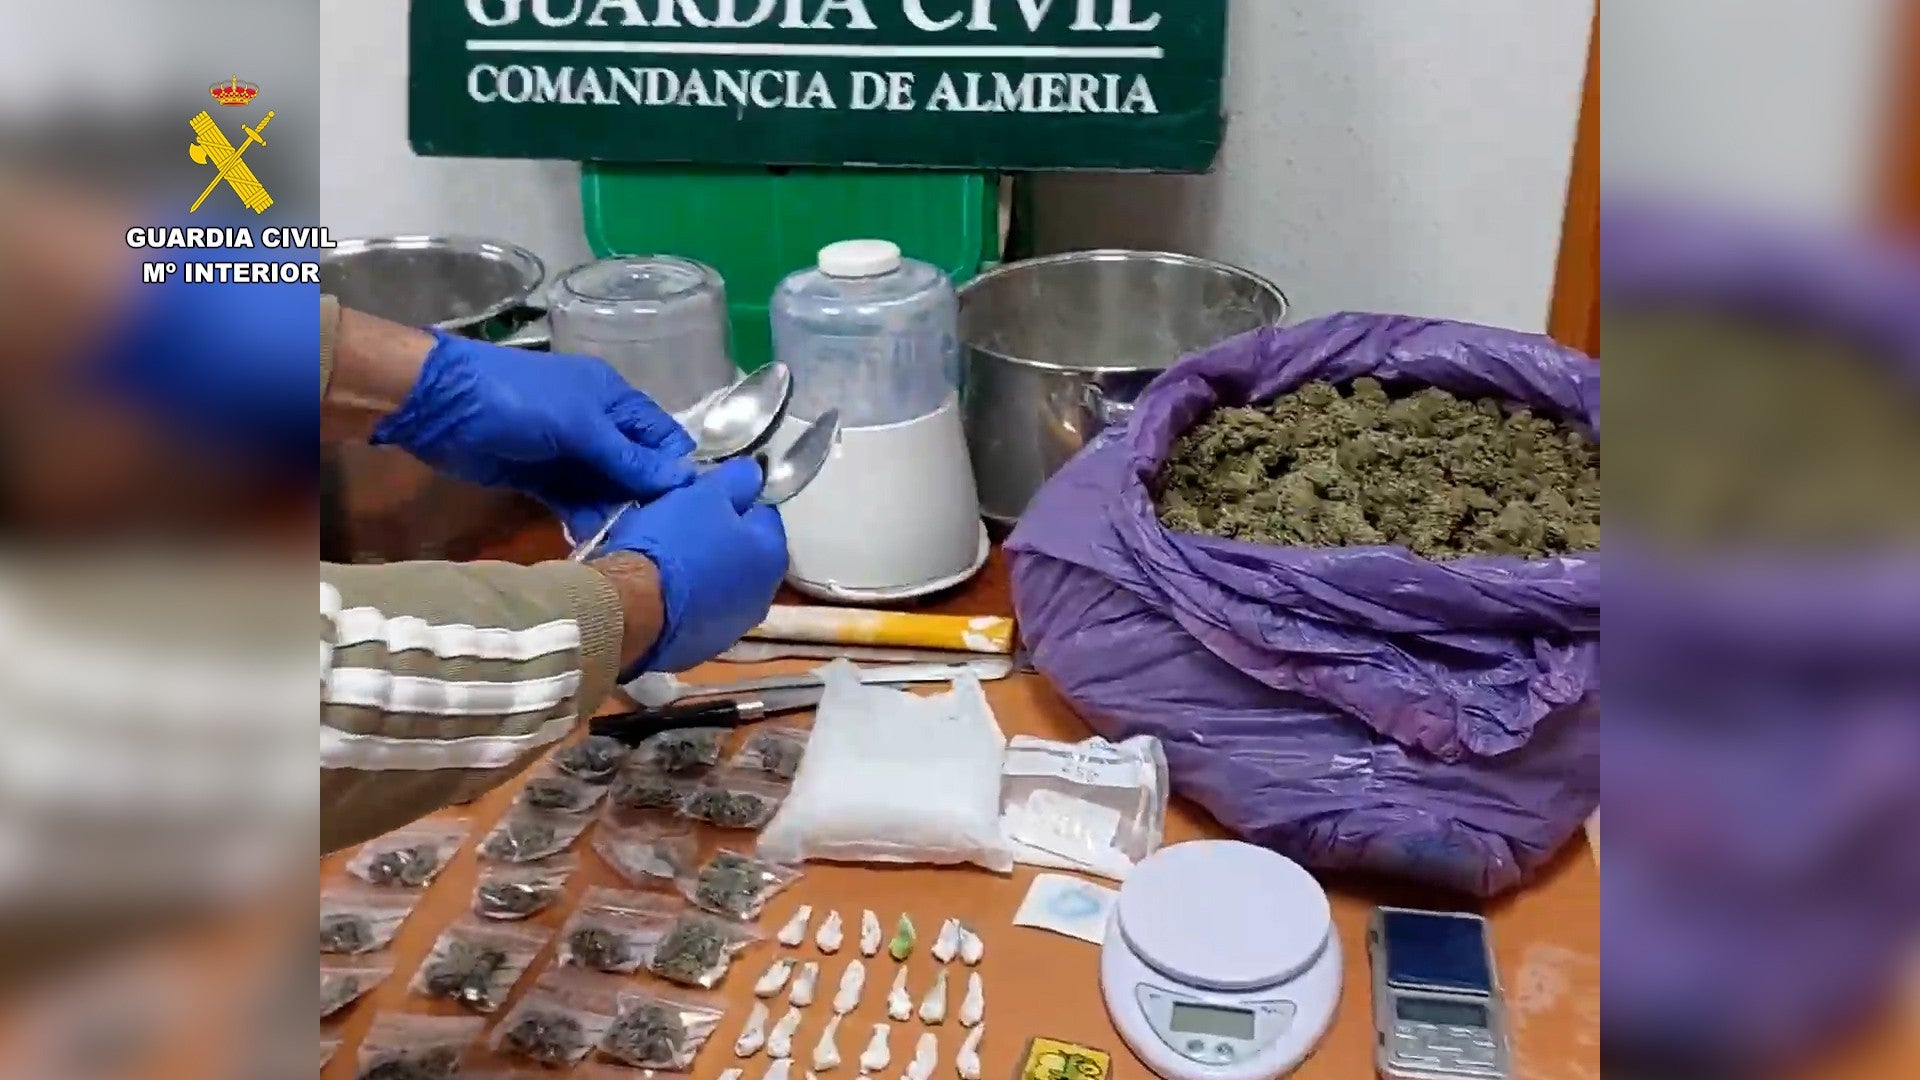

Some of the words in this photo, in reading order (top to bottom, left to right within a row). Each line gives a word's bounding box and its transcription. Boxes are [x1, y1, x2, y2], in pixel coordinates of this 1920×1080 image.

[467, 64, 837, 110] COMANDANCIA
[850, 71, 916, 111] DE
[926, 72, 1160, 114] ALMERIA
